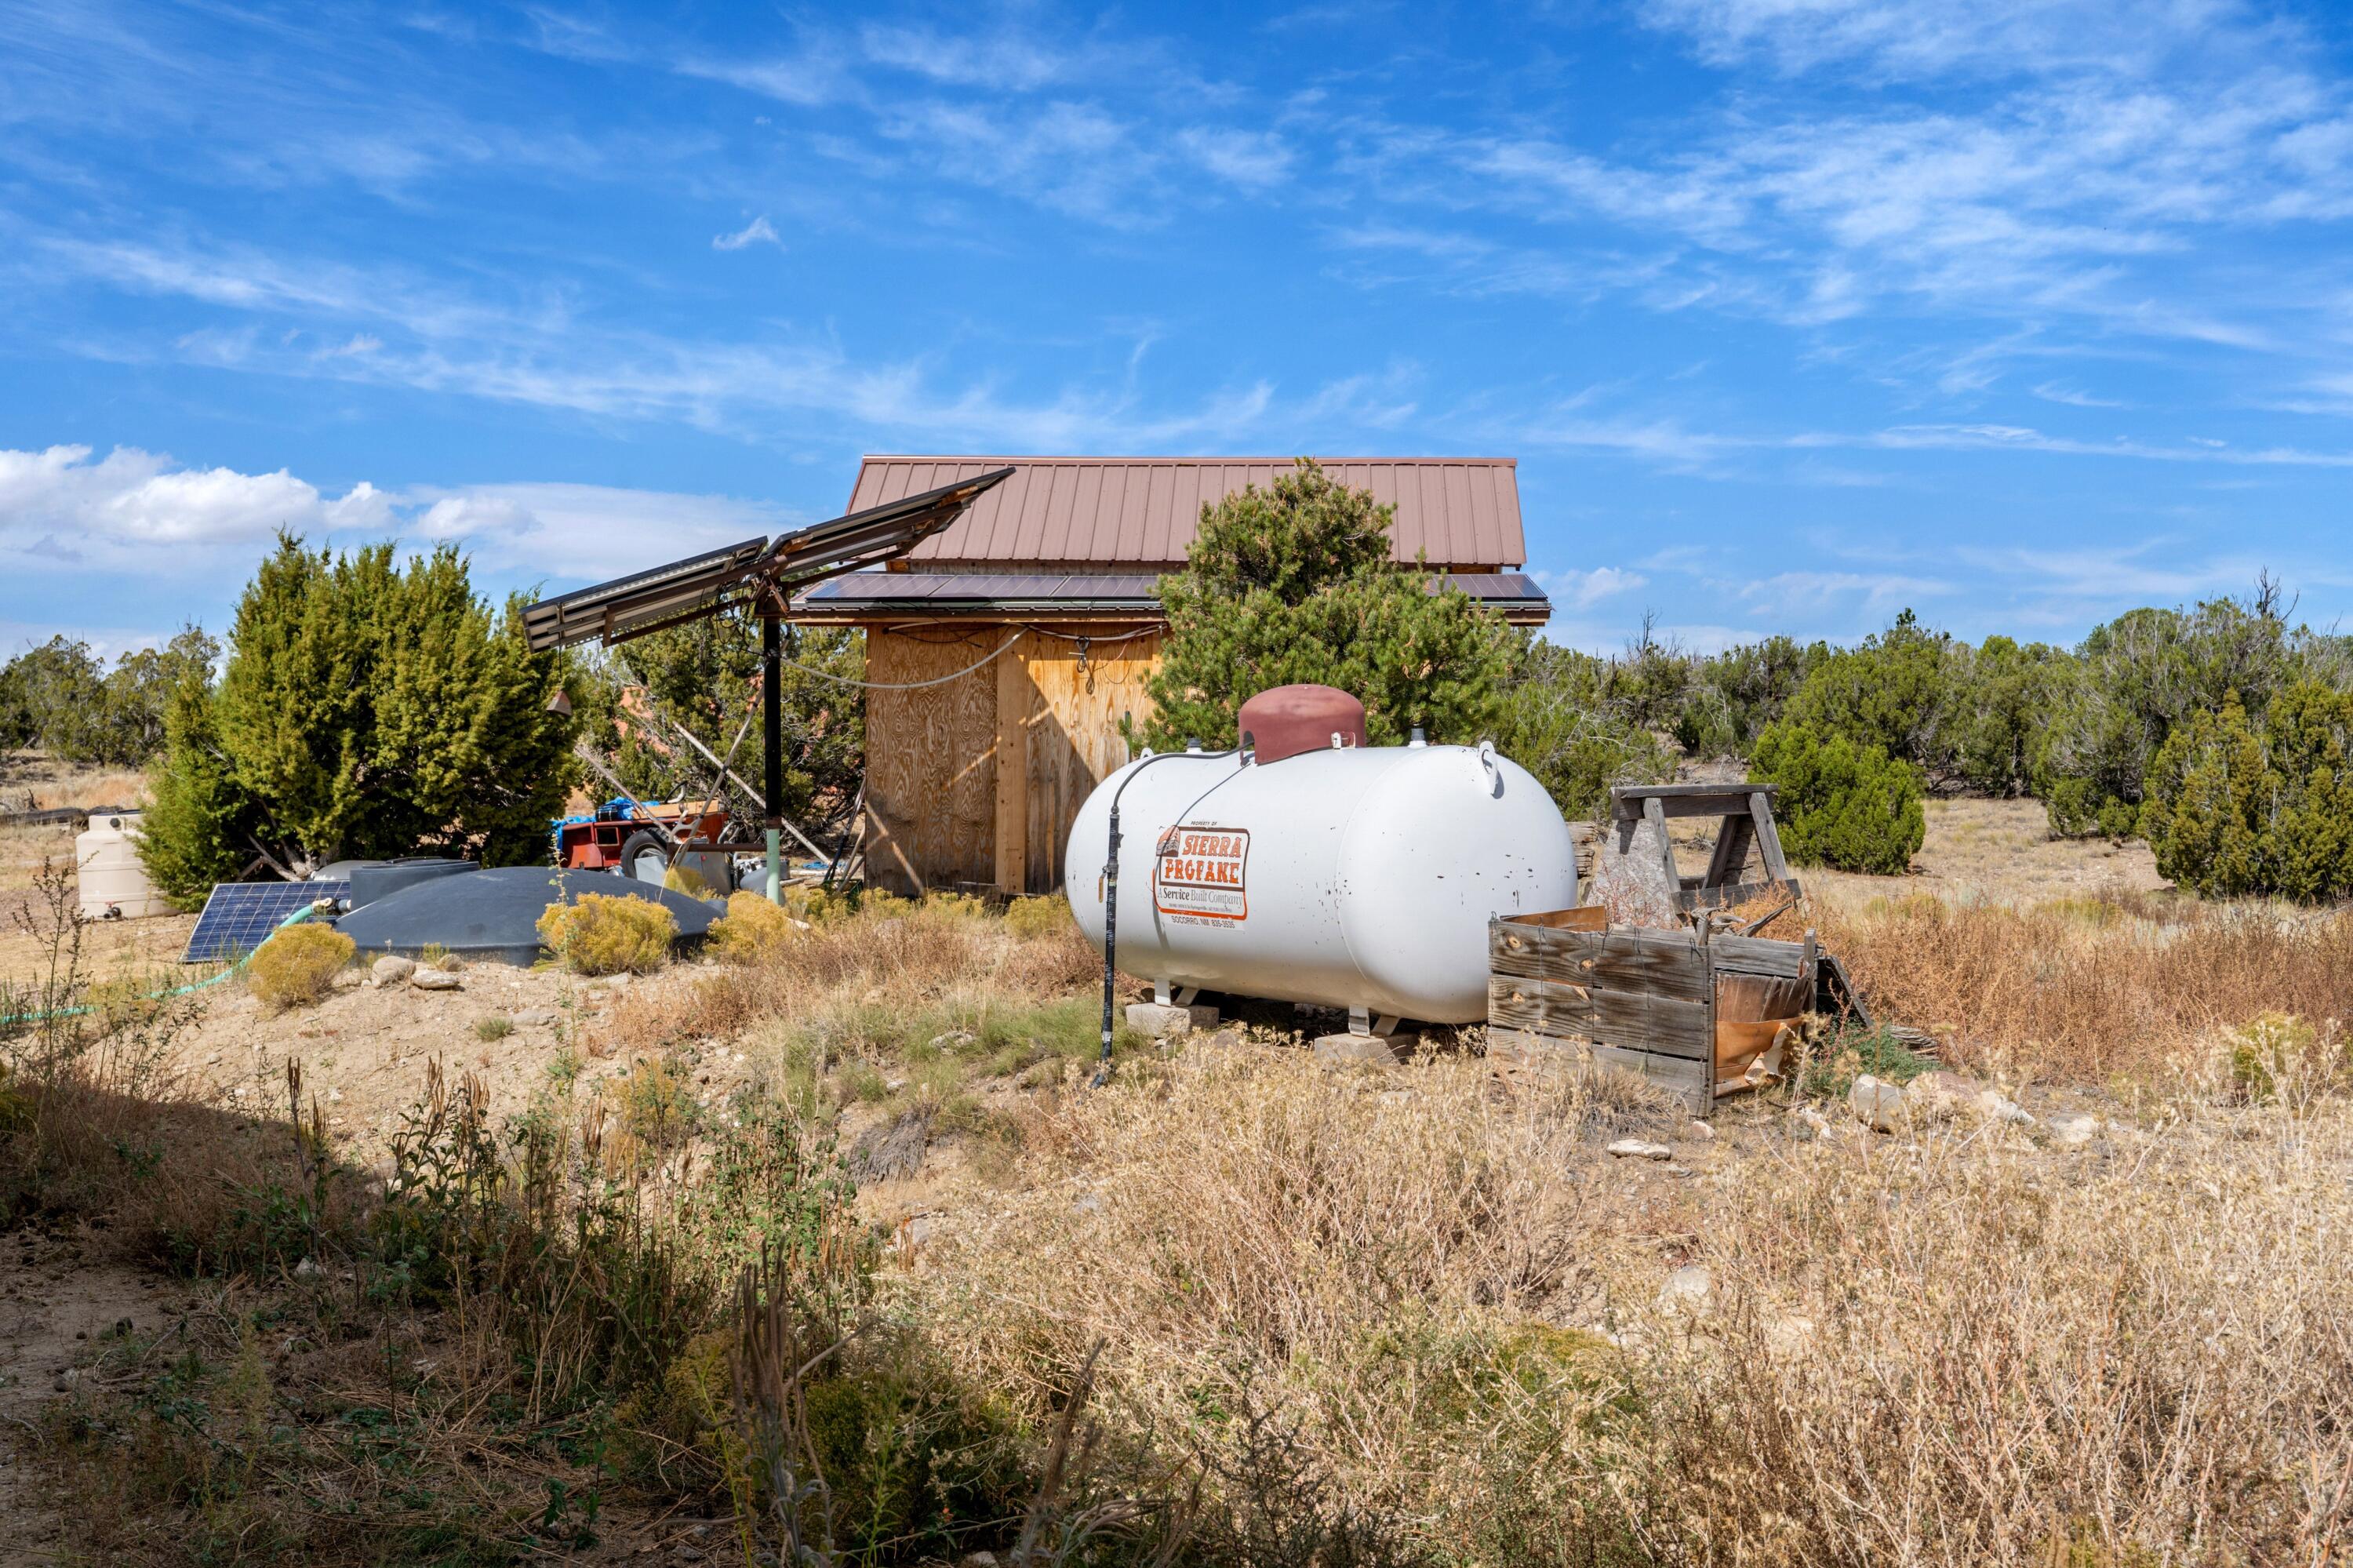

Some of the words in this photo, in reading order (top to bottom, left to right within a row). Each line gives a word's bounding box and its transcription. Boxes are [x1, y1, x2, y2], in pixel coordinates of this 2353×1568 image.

[1182, 835, 1242, 858] SIERRA
[1157, 887, 1162, 899] A
[1164, 887, 1190, 901] Service
[1191, 890, 1208, 903] Built
[1208, 891, 1243, 906] Company
[1200, 918, 1210, 926] NM
